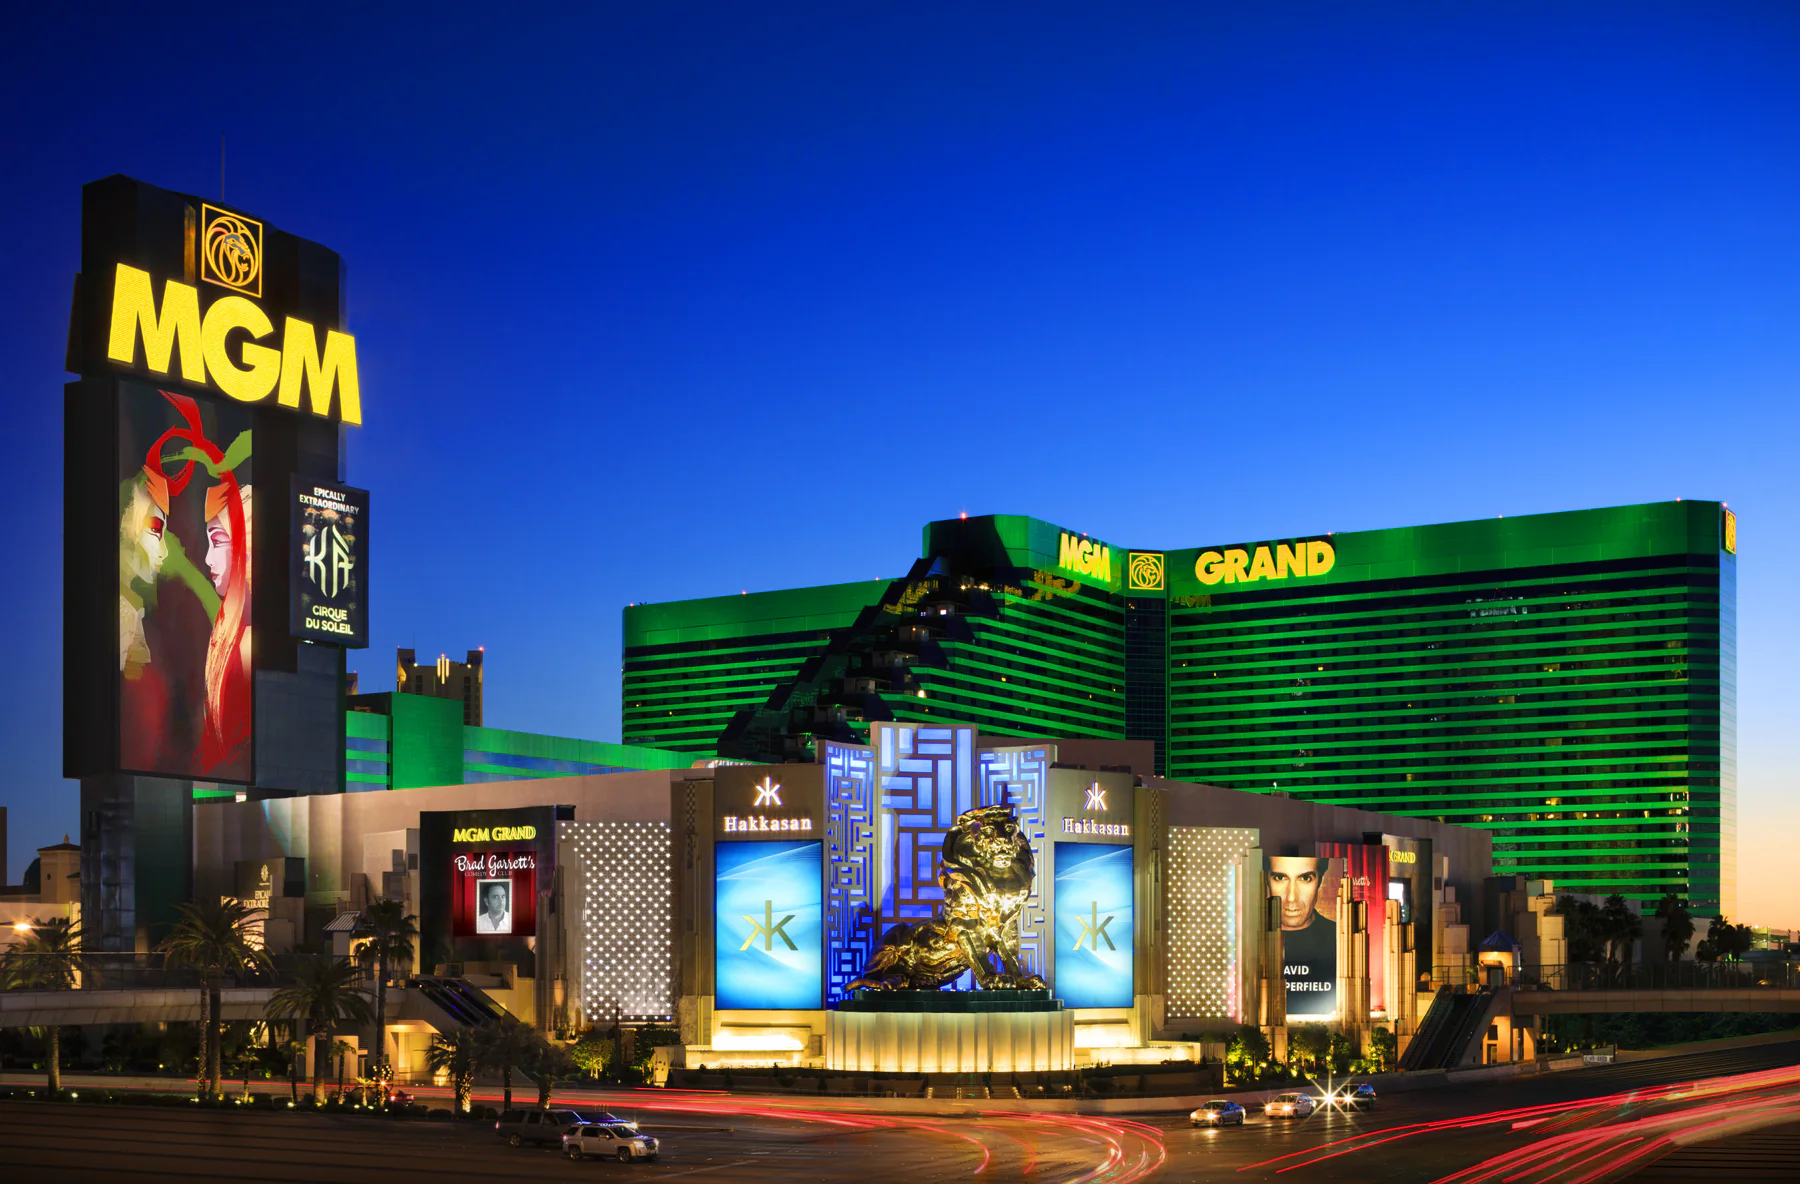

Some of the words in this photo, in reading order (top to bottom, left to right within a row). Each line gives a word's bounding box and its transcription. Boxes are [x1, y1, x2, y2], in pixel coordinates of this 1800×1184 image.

[107, 262, 362, 426] MGM
[314, 486, 346, 502] EPICALLY
[299, 494, 360, 515] EXTRAORDINARY
[1058, 532, 1111, 582] MGM
[1195, 541, 1336, 585] GRAND
[312, 605, 348, 622] CIRQUE
[305, 617, 321, 630] DU
[321, 619, 354, 635] SOLEIL
[723, 815, 812, 831] Hakkasan
[1062, 817, 1129, 836] Hakkasan
[452, 827, 491, 842] MGM
[491, 825, 536, 841] GRAND
[454, 855, 485, 872] Brad
[487, 854, 535, 877] Garrett's
